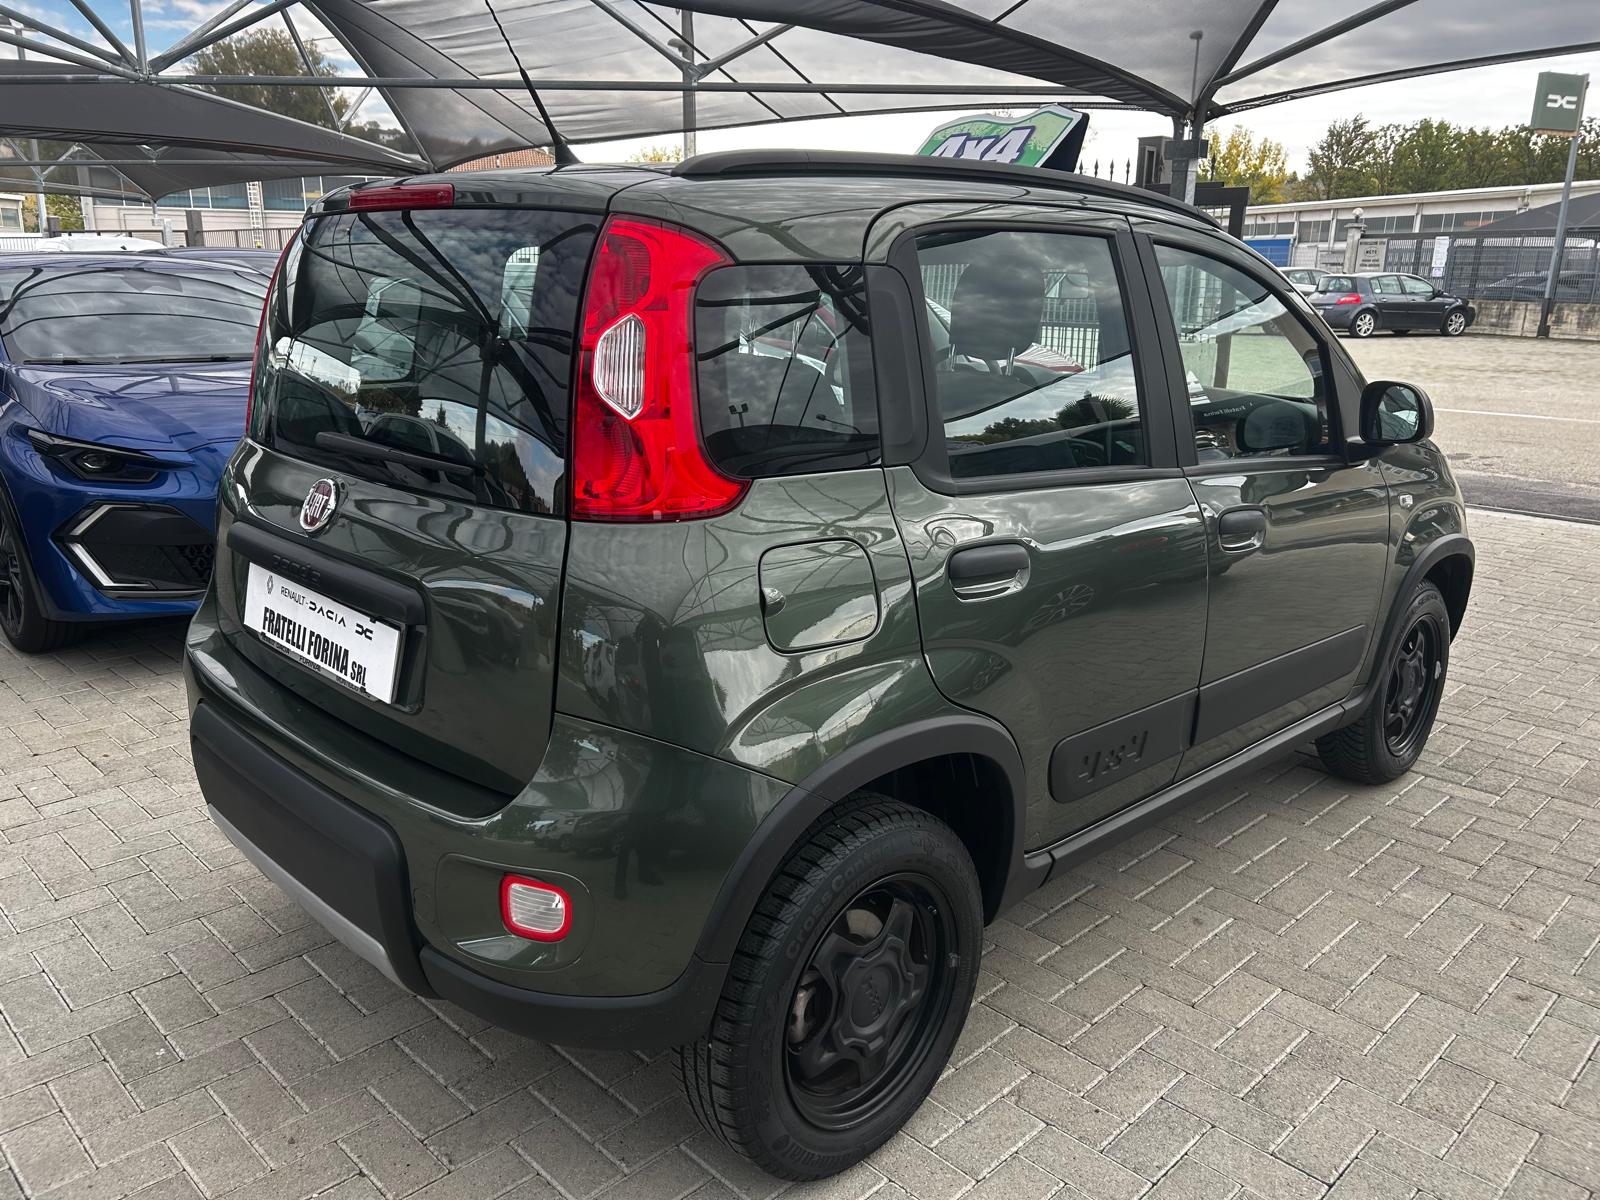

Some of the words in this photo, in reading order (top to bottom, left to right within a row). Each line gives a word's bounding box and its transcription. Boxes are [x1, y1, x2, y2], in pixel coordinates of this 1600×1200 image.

[306, 491, 329, 520] FIAT
[262, 606, 307, 652] FRATELLI
[307, 629, 349, 677] FORINA
[350, 661, 367, 687] SRL
